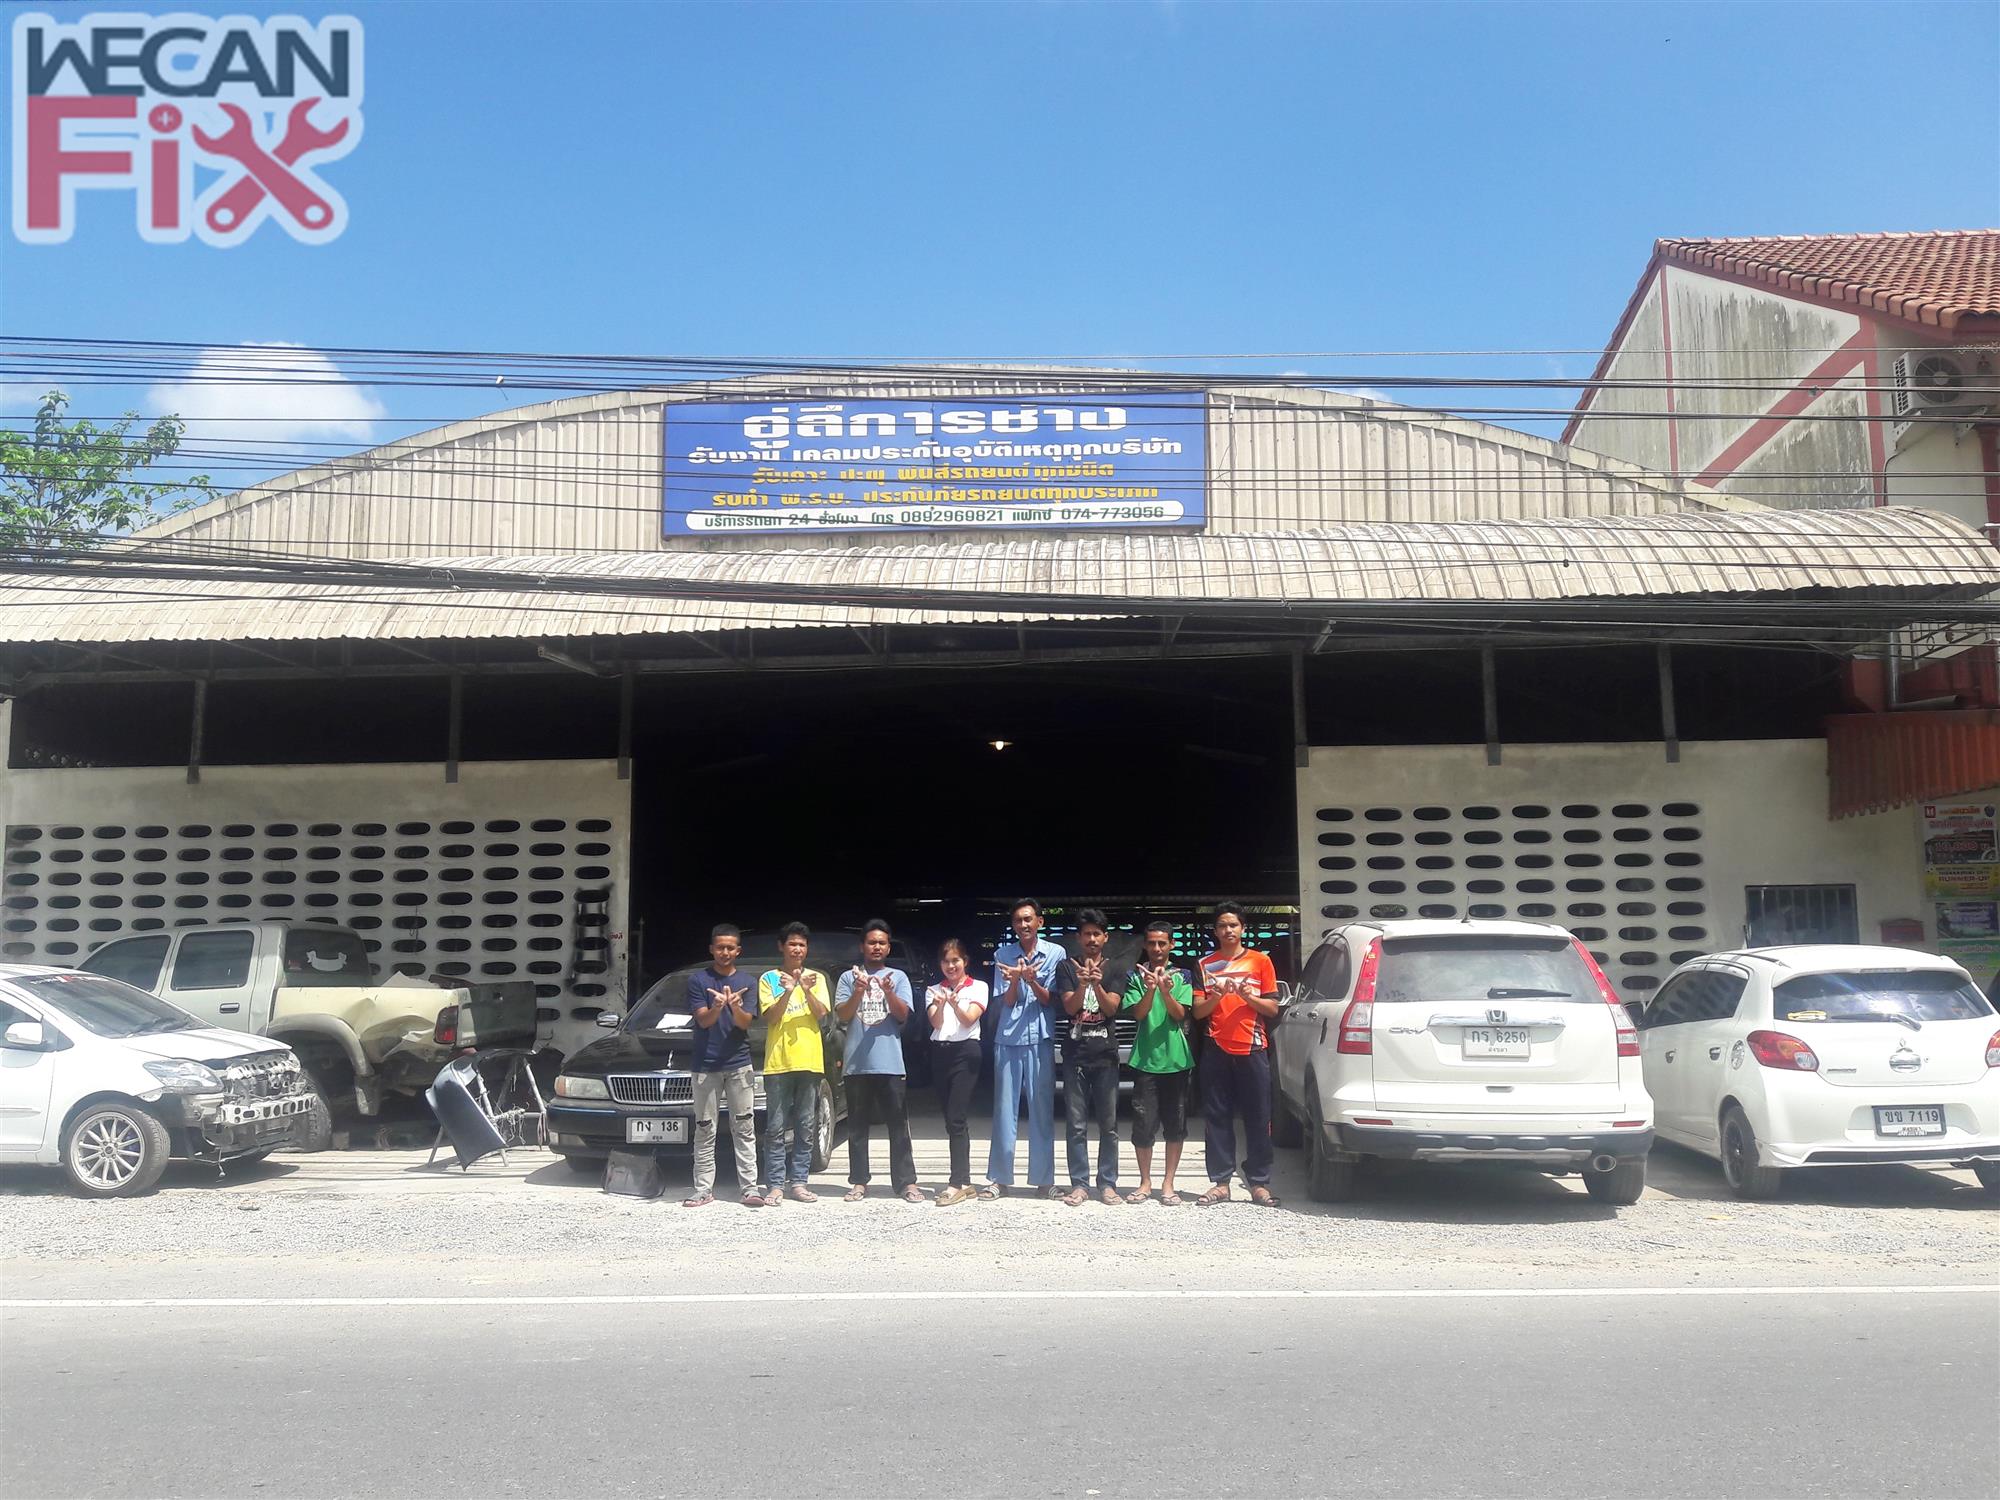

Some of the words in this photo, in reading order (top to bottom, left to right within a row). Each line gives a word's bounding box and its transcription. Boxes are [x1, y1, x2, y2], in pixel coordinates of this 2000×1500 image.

[788, 513, 810, 526] 24
[900, 509, 1004, 523] 0892969821
[1061, 506, 1165, 521] 074-773056
[1471, 1030, 1490, 1043] กร
[1496, 1030, 1527, 1044] 6250
[1909, 1110, 1939, 1122] 7119
[661, 1121, 679, 1132] 136
